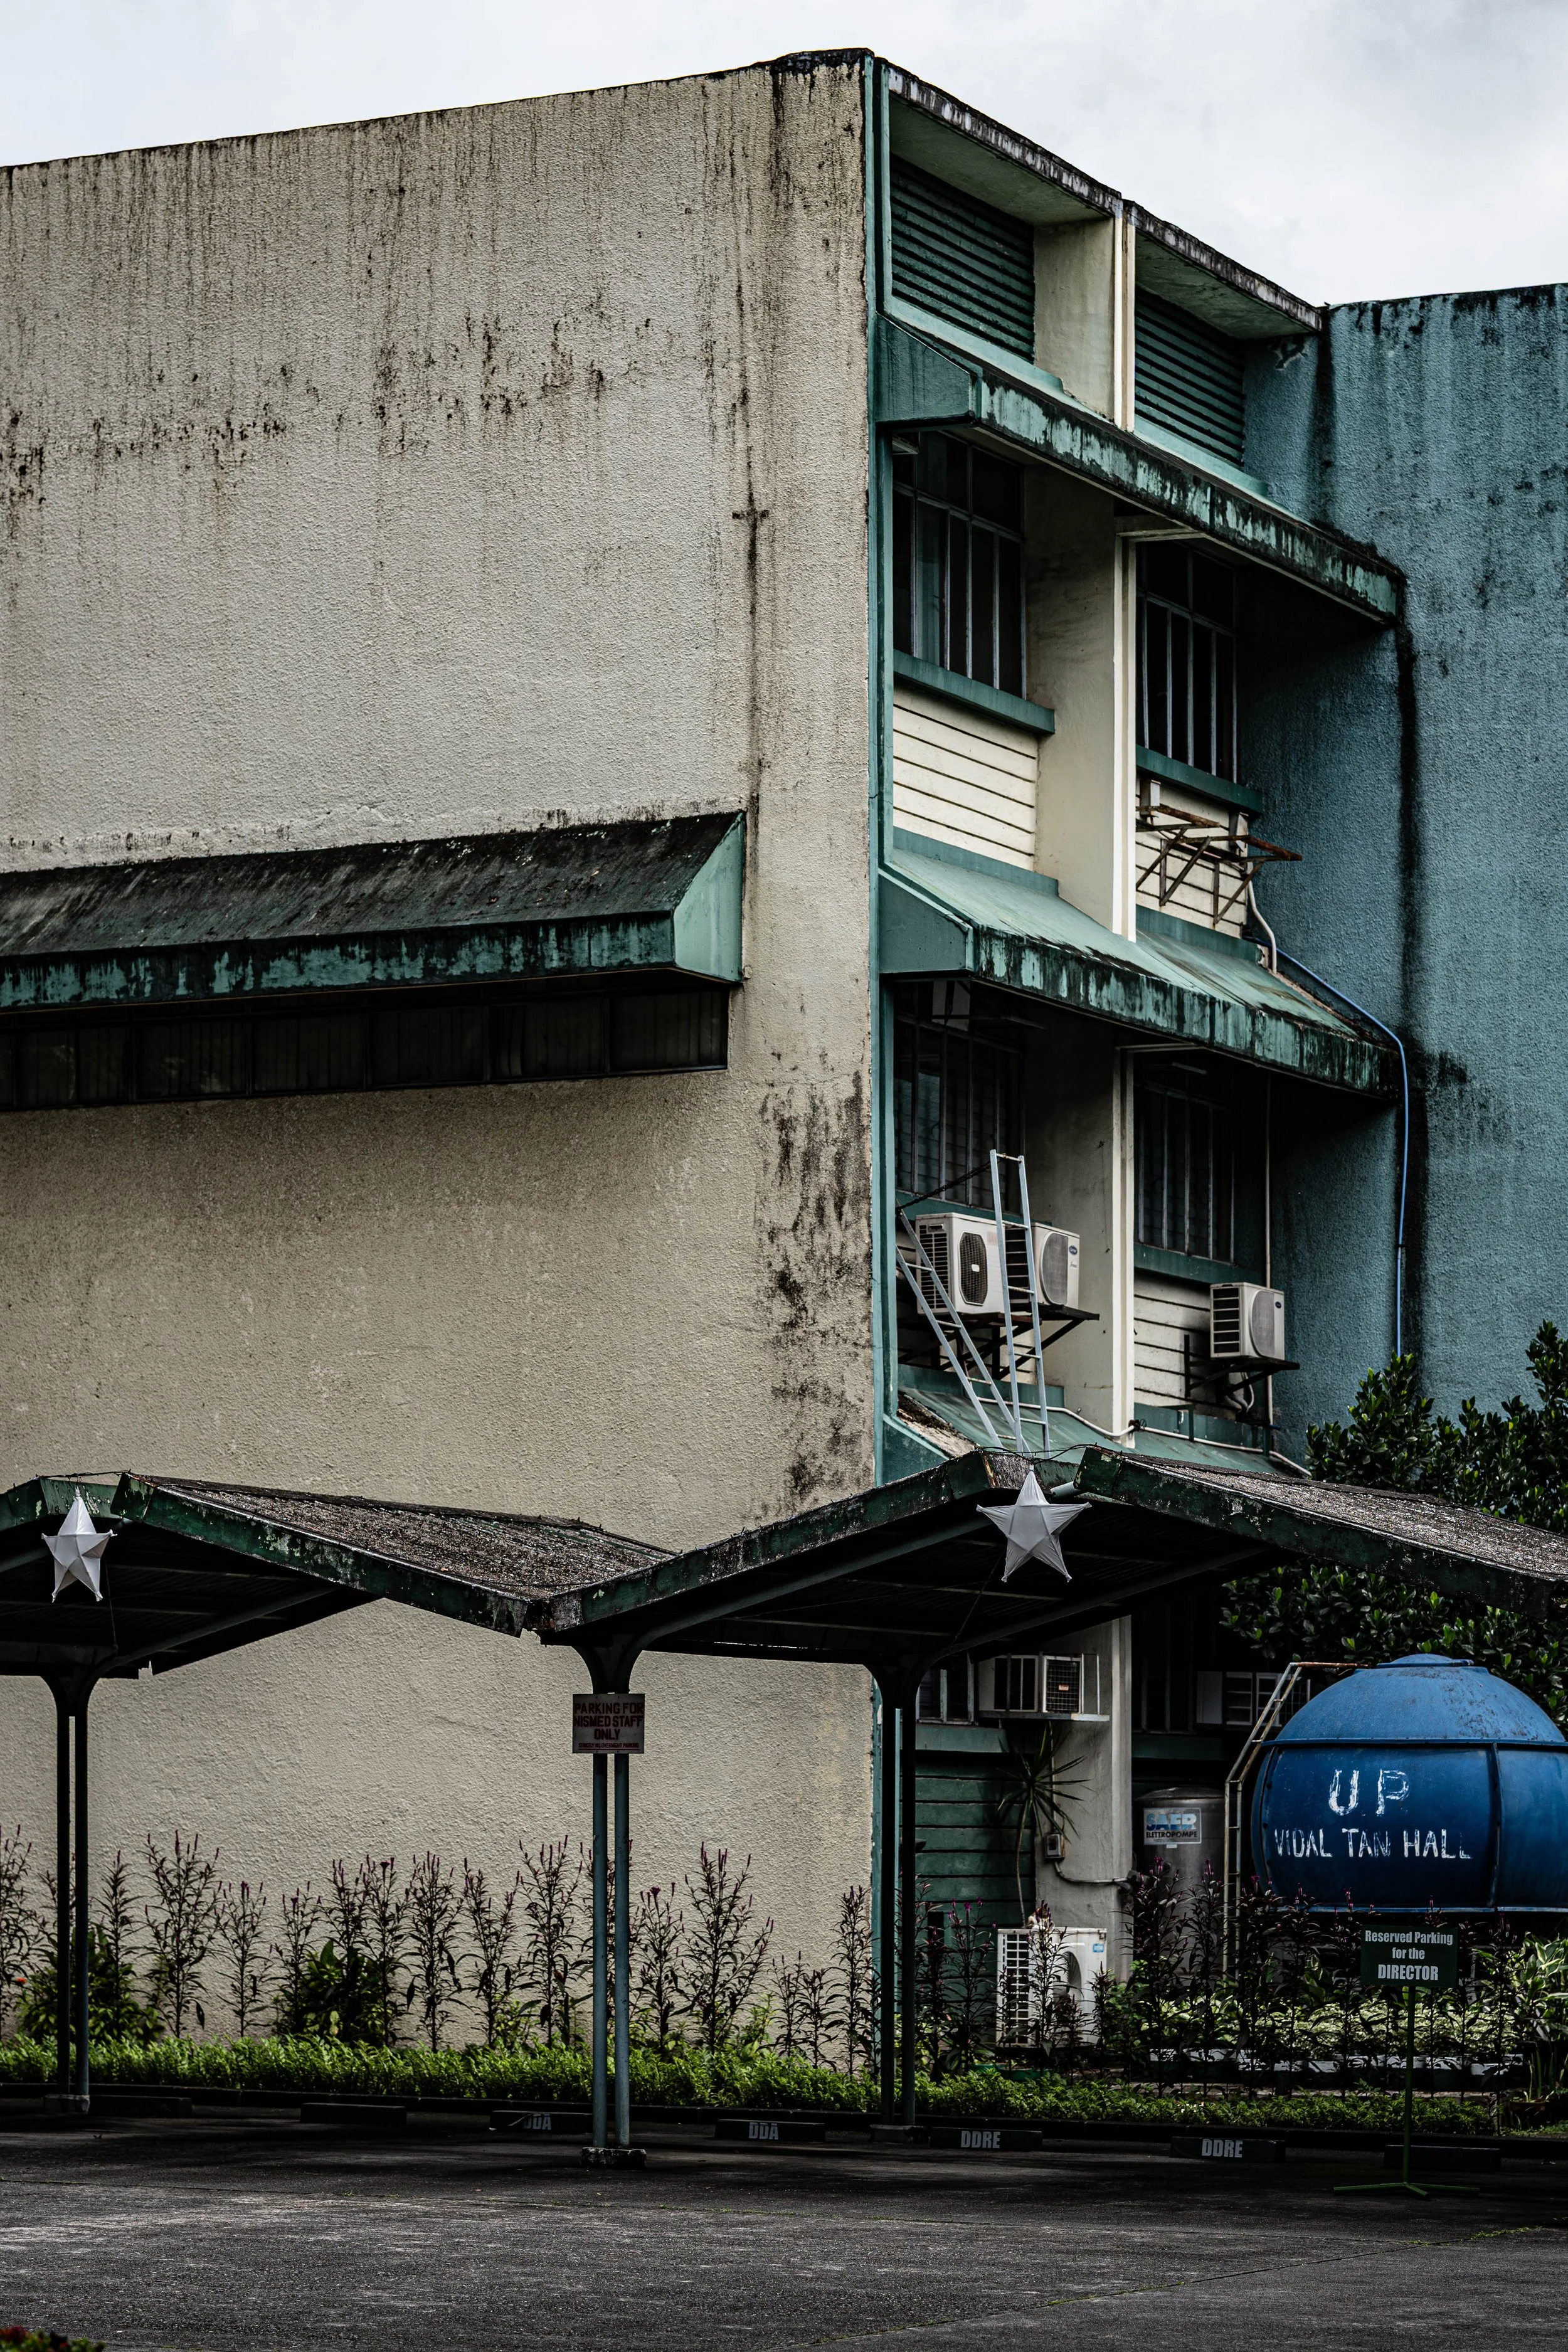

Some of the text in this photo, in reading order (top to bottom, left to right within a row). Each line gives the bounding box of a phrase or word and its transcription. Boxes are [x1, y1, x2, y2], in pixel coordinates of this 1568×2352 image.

[575, 1702, 644, 1714] PARKING FOR
[573, 1715, 644, 1727] NISMED STAFF
[594, 1729, 620, 1740] ONLY
[1146, 1813, 1197, 1831] SAER
[1274, 1828, 1473, 1859] VIDAL TAN HALL
[1365, 1930, 1453, 1946] Reserved Parking
[1392, 1947, 1425, 1959] for the
[1377, 1964, 1439, 1981] DIRECTOR
[748, 2122, 779, 2140] DDA
[961, 2131, 1001, 2148] DDRE
[1202, 2139, 1243, 2158] DDRE
